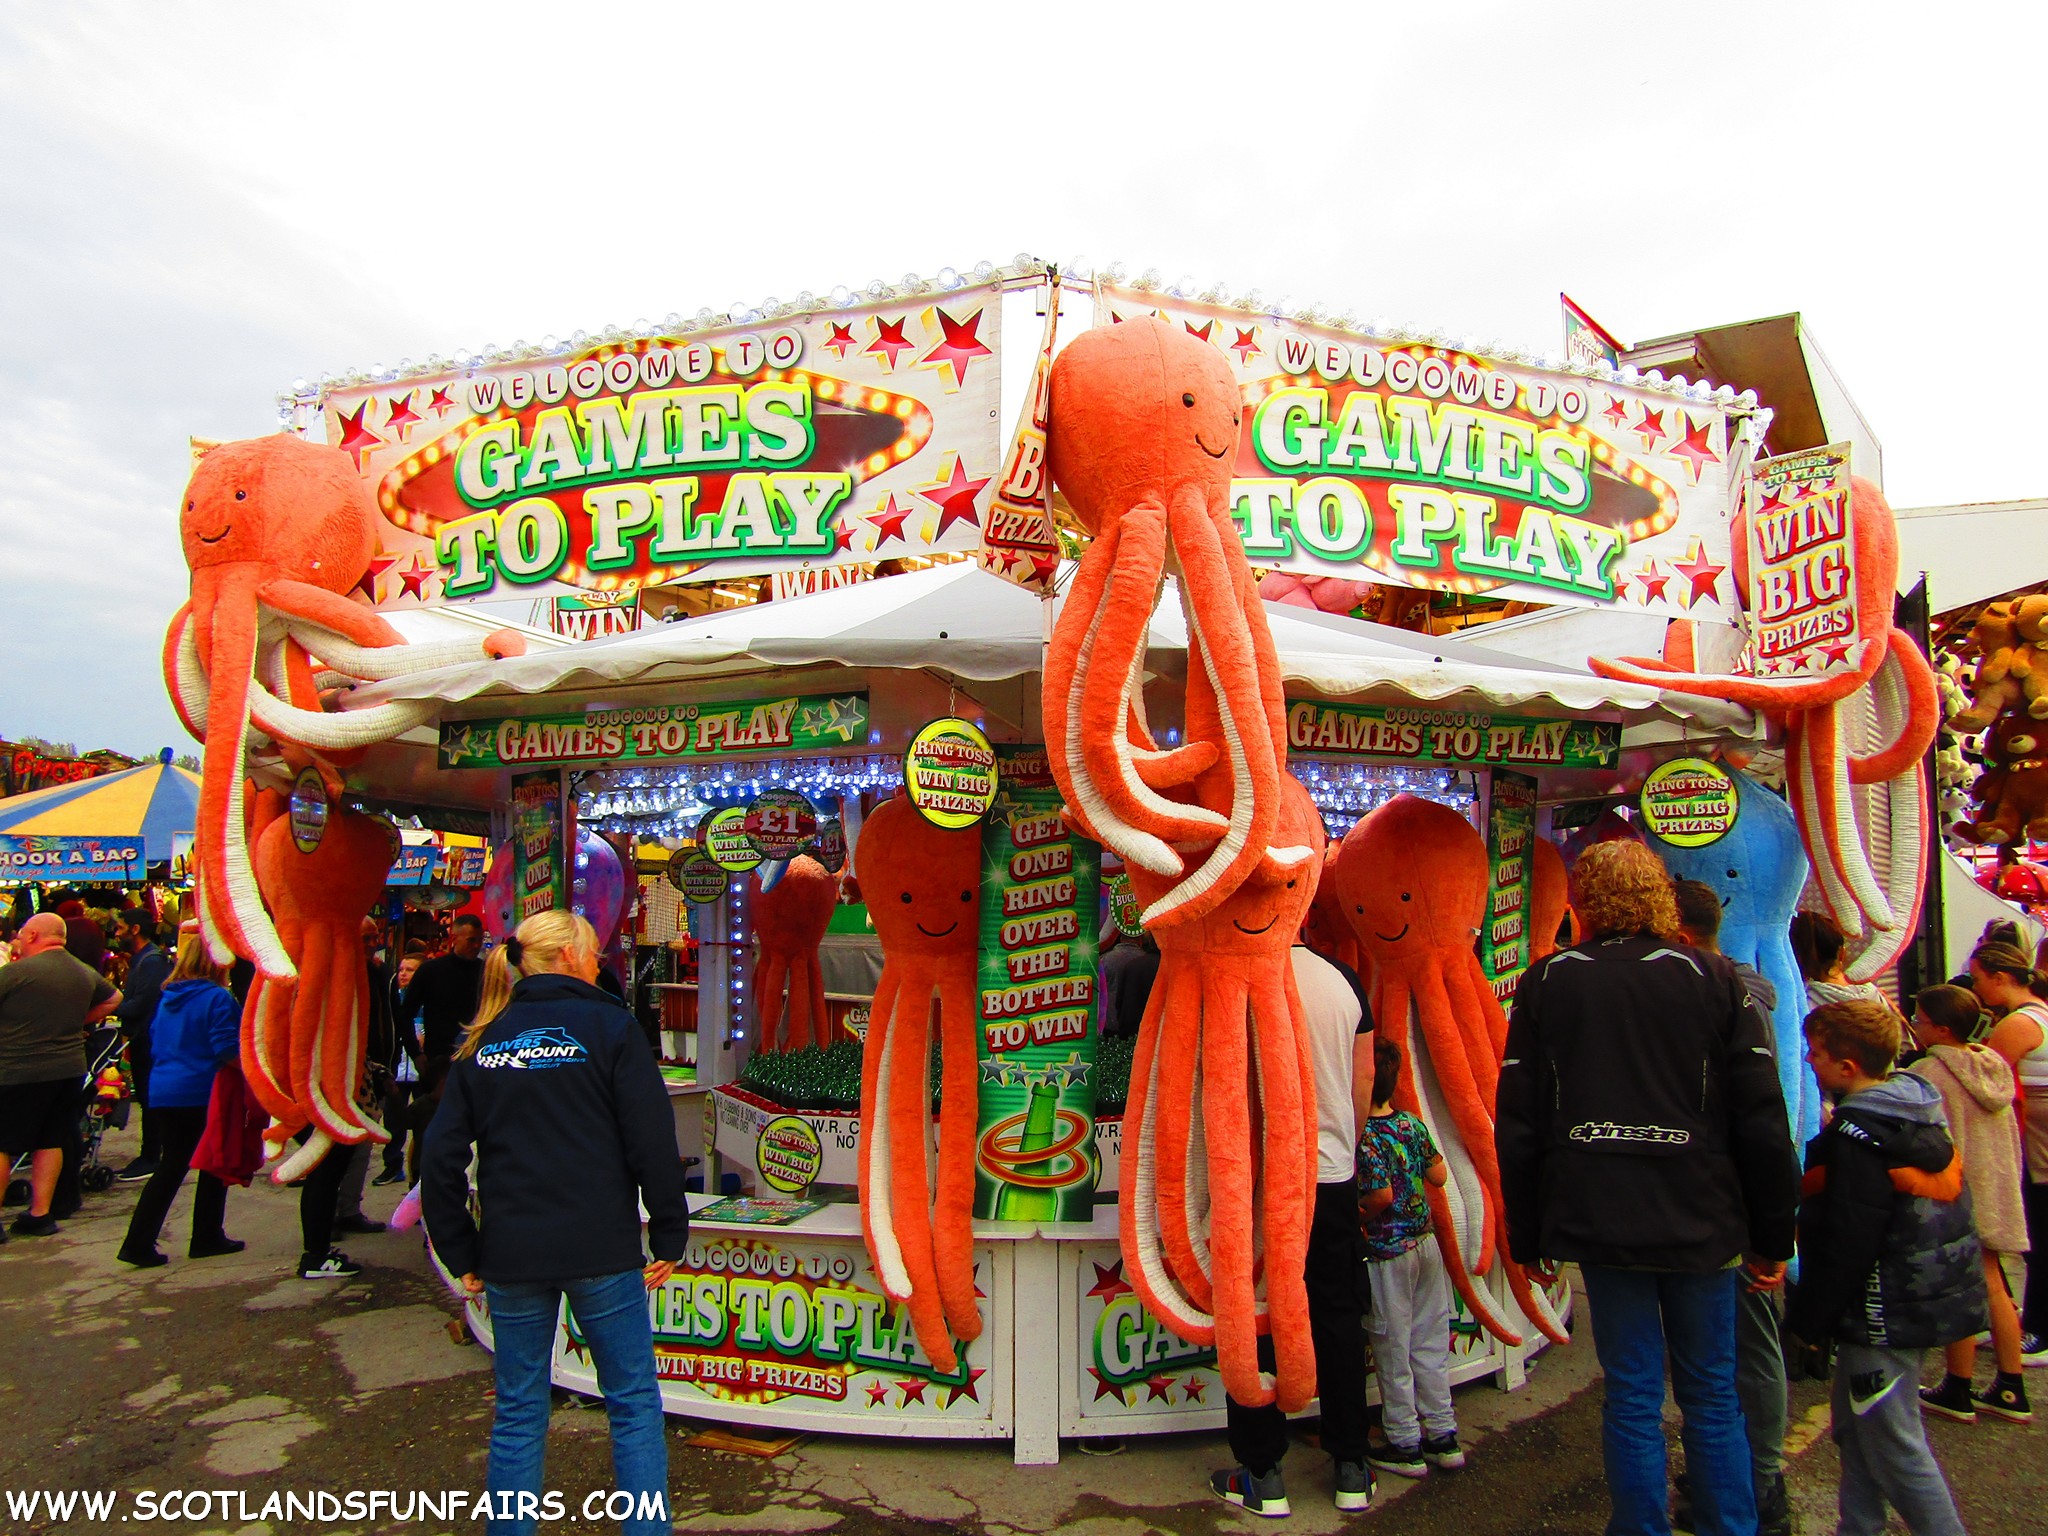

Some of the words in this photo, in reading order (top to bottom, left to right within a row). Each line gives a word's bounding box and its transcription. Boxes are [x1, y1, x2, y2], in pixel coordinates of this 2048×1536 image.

[468, 345, 709, 411] WELCOME
[734, 332, 799, 369] TO
[1279, 334, 1512, 405] WELCOME
[1529, 380, 1585, 419] TO
[458, 385, 812, 504] GAMES
[1256, 390, 1590, 508] GAMES
[1765, 474, 1787, 489] TO
[1791, 466, 1836, 481] PLAY
[1769, 456, 1829, 476] GAMES
[439, 504, 563, 593] TO
[588, 472, 847, 564] PLAY
[1235, 477, 1367, 559] TO
[1391, 486, 1618, 597] PLAY
[1760, 491, 1846, 559] WIN
[780, 565, 861, 600] WIN
[1762, 548, 1844, 619] BIG
[558, 608, 636, 641] WIN
[1762, 608, 1850, 654] PRIZES
[585, 707, 669, 725] WELCOME
[674, 706, 698, 721] TO
[1385, 707, 1466, 726] WELCOME
[1470, 713, 1492, 728] TO
[498, 719, 625, 763] GAMES
[632, 719, 688, 755] TO
[698, 698, 798, 750] PLAY
[1288, 702, 1423, 753] GAMES
[1431, 726, 1480, 758] TO
[1487, 720, 1572, 761] PLAY
[916, 740, 955, 757] RING
[957, 745, 994, 766] TOSS
[14, 751, 100, 783] GHOST
[916, 769, 954, 789] WIN
[957, 774, 989, 794] BIG
[1647, 779, 1687, 793] RING
[1689, 777, 1729, 790] TOSS
[918, 792, 985, 814] PRIZES
[1651, 803, 1689, 817] WIN
[1694, 801, 1727, 815] BIG
[711, 823, 738, 833] RING
[759, 807, 800, 834] £1
[1015, 818, 1066, 844] GET
[1656, 818, 1725, 833] PRIZES
[526, 833, 549, 858] GET
[713, 840, 738, 850] WIN
[775, 835, 797, 843] PLAY
[1500, 836, 1522, 855] GET
[0, 852, 62, 867] HOOK
[69, 851, 85, 864] A
[92, 847, 138, 863] BAG
[405, 857, 428, 869] BAG
[716, 852, 762, 863] PRIZES
[1012, 849, 1069, 876] ONE
[1, 864, 45, 880] Prize
[526, 862, 550, 887] ONE
[685, 876, 703, 885] WIN
[706, 876, 722, 885] BIG
[1498, 862, 1520, 883] ONE
[686, 887, 721, 895] PRIZES
[1006, 881, 1073, 912] RING
[1493, 891, 1521, 912] RING
[525, 892, 552, 916] RING
[1002, 915, 1075, 945] OVER
[1492, 917, 1521, 941] OVER
[1011, 949, 1066, 977] THE
[1494, 947, 1518, 970] THE
[985, 979, 1090, 1014] BOTTLE
[988, 1023, 1026, 1048] TO
[1031, 1013, 1085, 1041] WIN
[483, 1037, 542, 1055] OLIVERS
[517, 1046, 579, 1059] MOUNT
[528, 1062, 560, 1070] CIRCUIT
[812, 1119, 843, 1135] W.R.
[1569, 1121, 1689, 1144] alpinestars
[767, 1130, 792, 1145] RING
[793, 1137, 819, 1154] TOSS
[836, 1135, 856, 1149] NO
[764, 1148, 788, 1164] WIN
[791, 1155, 812, 1172] BIG
[762, 1162, 807, 1185] PRIZES
[687, 1246, 795, 1275] LCOME
[807, 1252, 851, 1279] TO
[734, 1282, 811, 1347] TO
[656, 1354, 696, 1377] WIN
[701, 1357, 743, 1379] BIG
[749, 1363, 844, 1396] PRIZES
